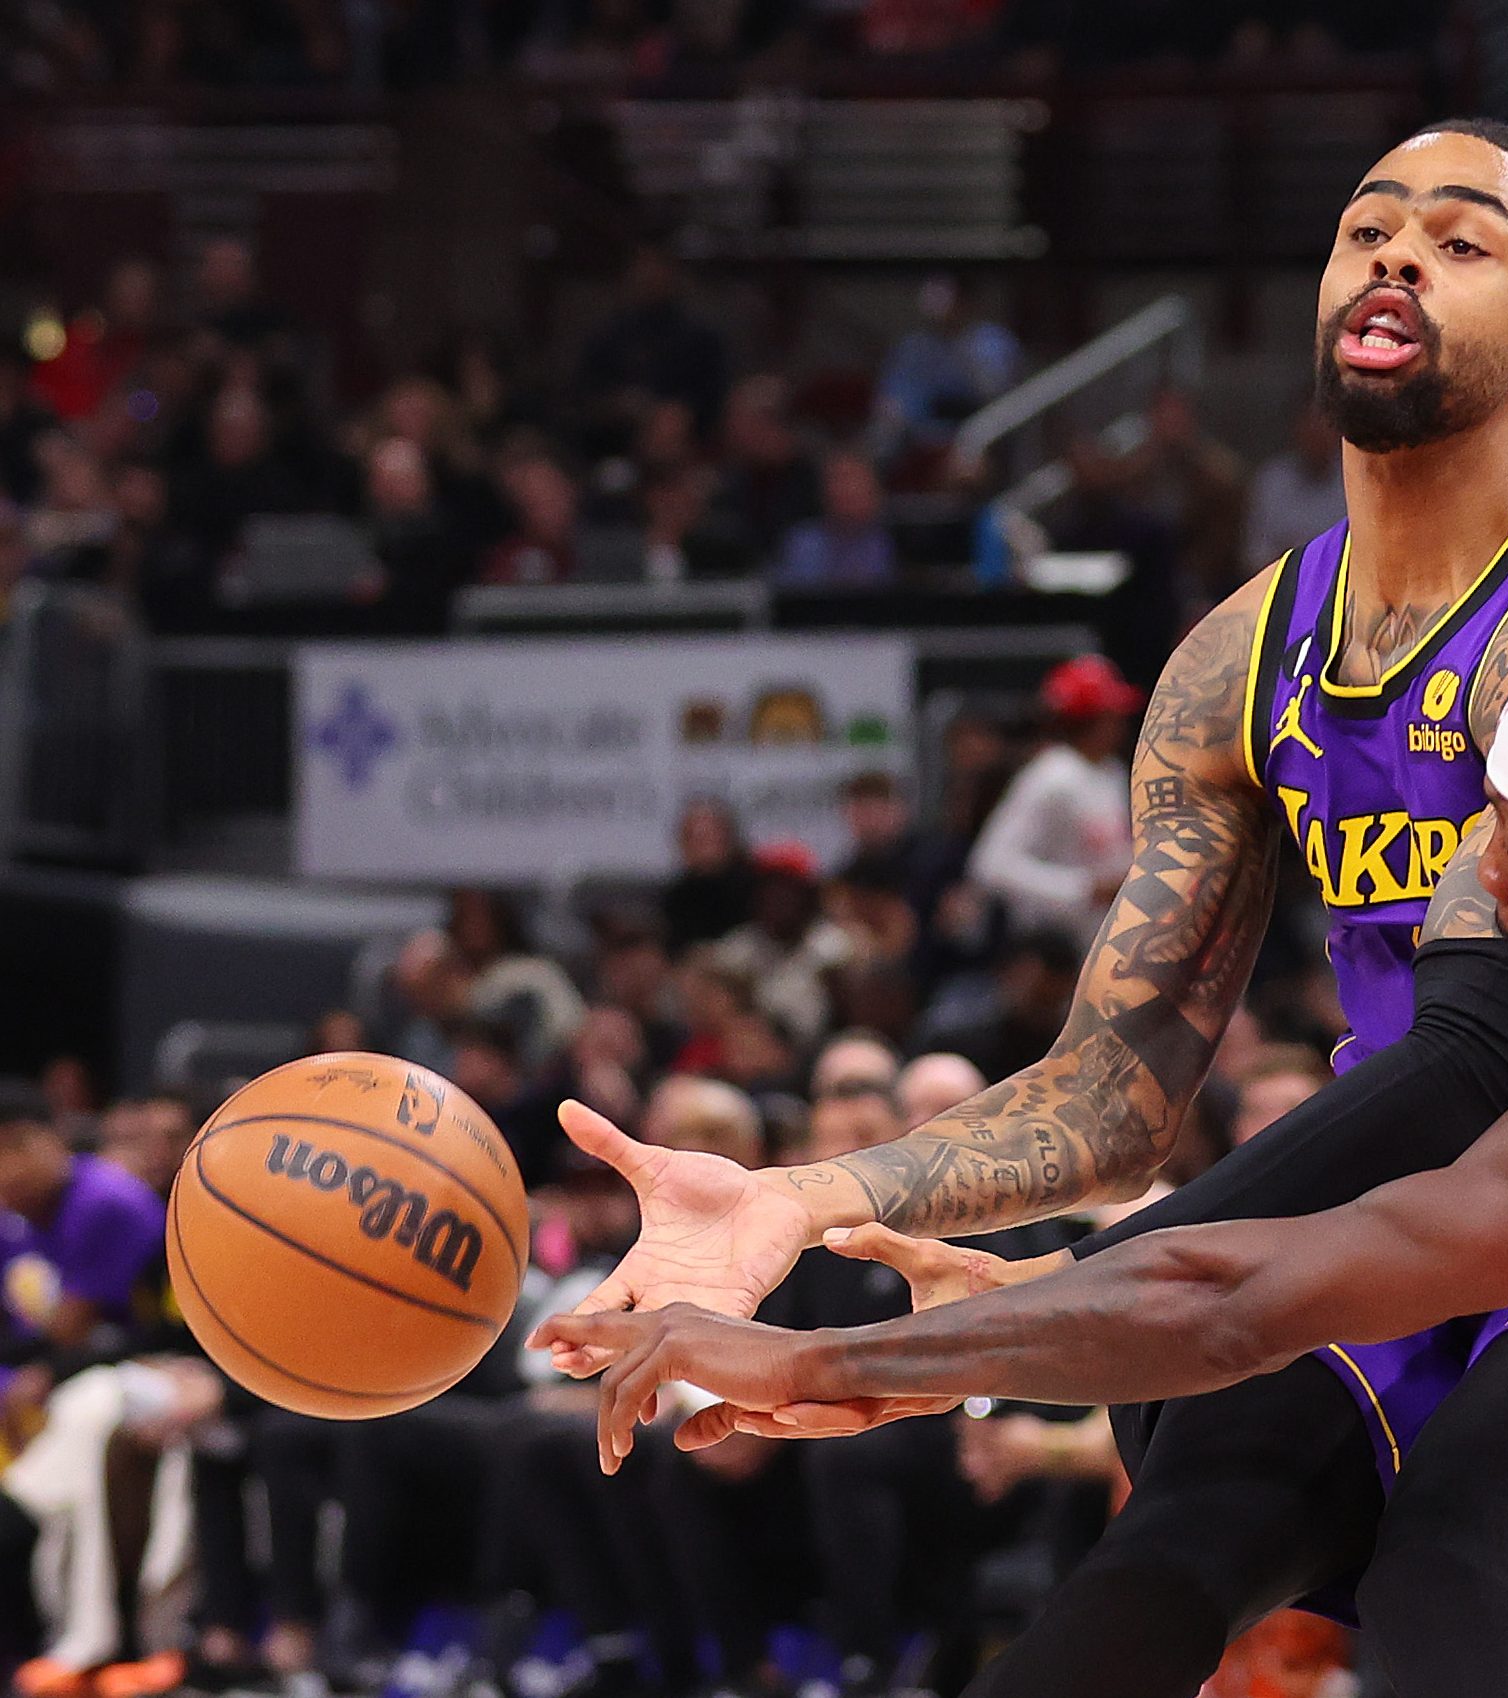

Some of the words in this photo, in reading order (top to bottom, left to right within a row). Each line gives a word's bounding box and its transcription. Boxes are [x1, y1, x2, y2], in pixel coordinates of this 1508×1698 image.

[1408, 723, 1467, 761] bibigo
[1276, 784, 1486, 908] LAKR
[264, 1133, 483, 1294] Wilson
